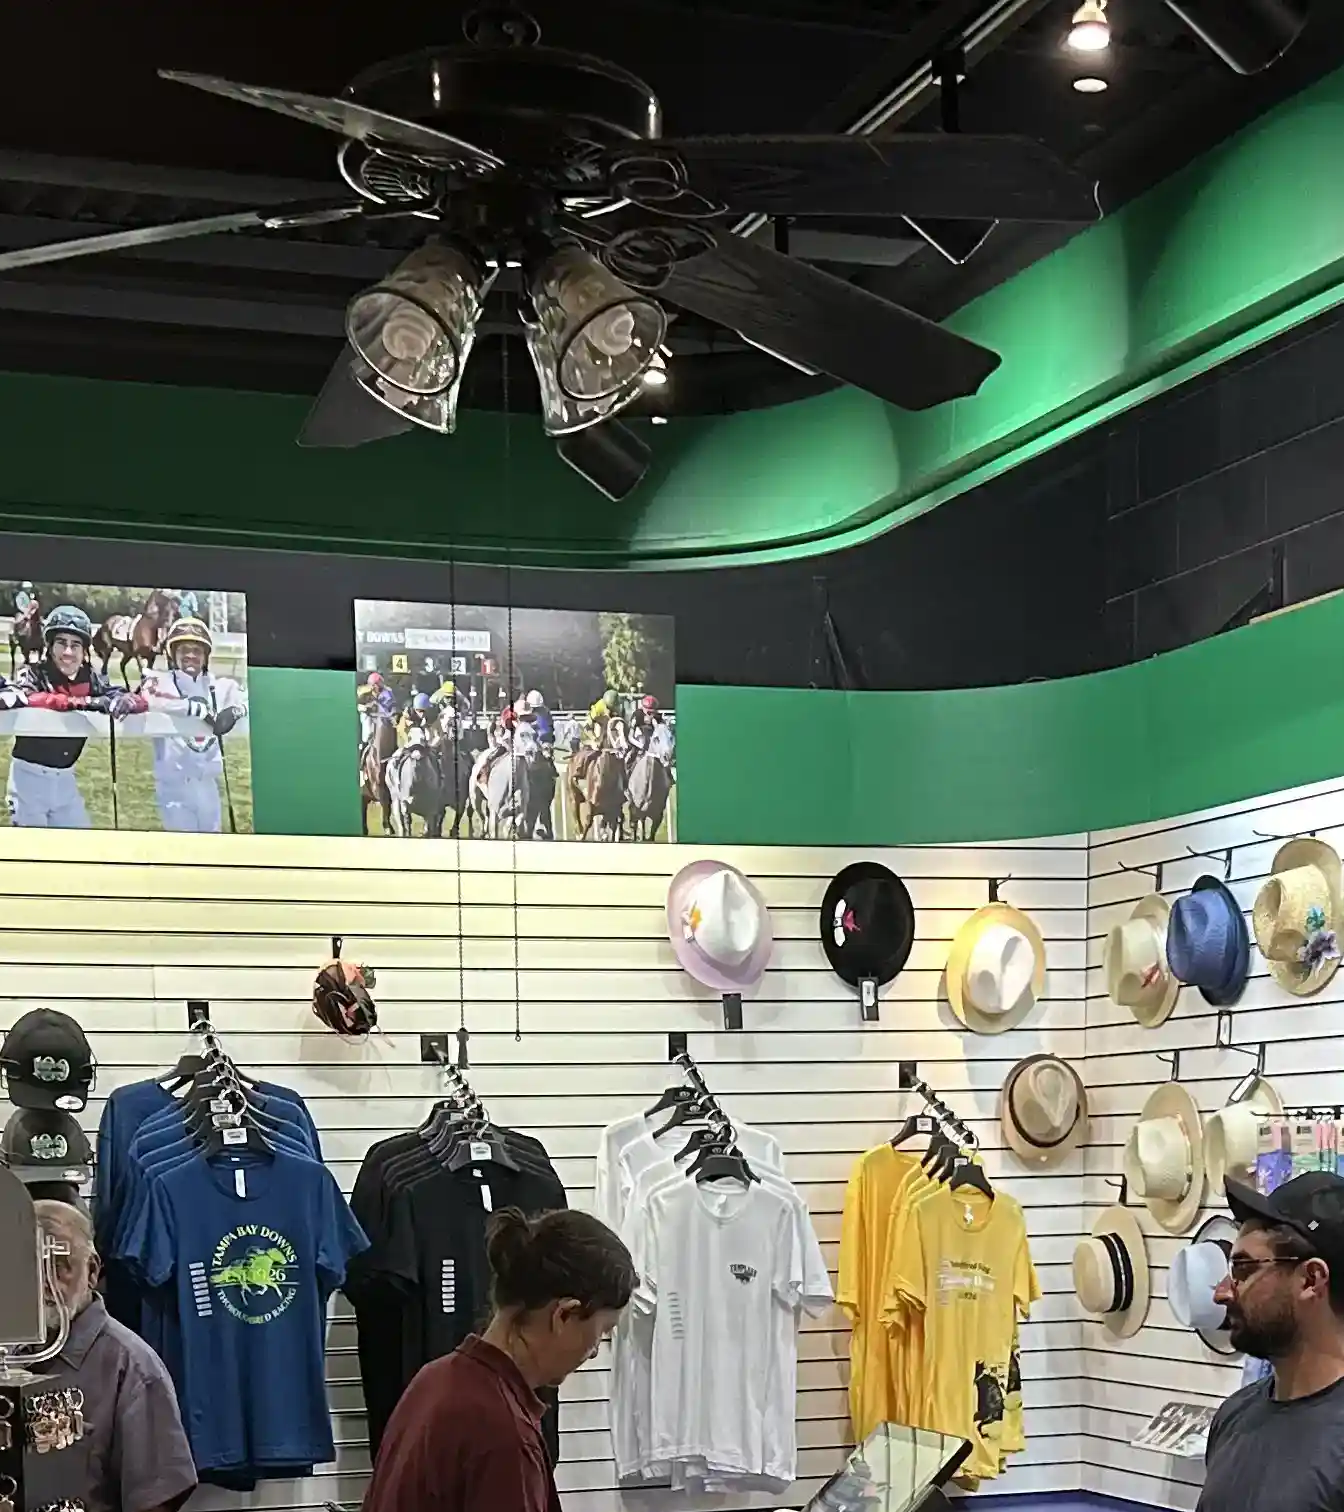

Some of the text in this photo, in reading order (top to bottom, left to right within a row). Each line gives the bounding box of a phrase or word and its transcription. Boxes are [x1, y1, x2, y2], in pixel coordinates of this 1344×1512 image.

[212, 1224, 297, 1266] TAMPA BAY DOWNS
[272, 1287, 297, 1318] RACING
